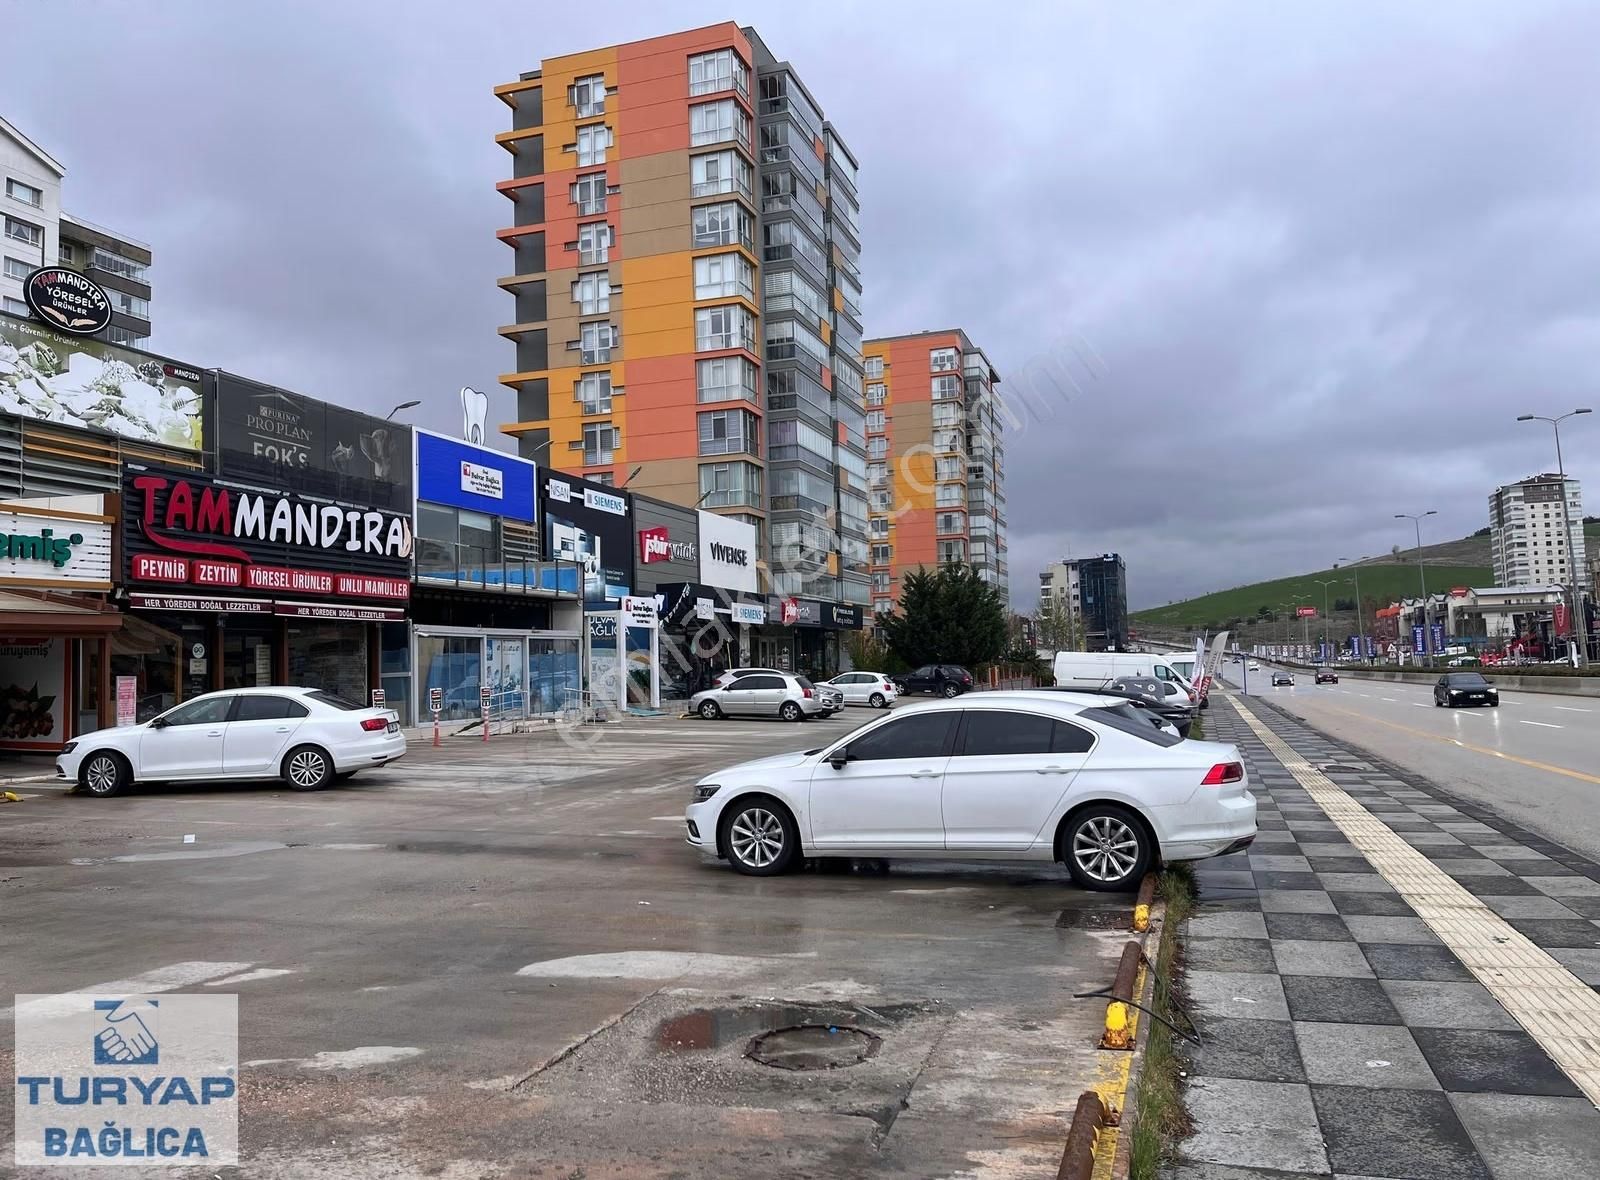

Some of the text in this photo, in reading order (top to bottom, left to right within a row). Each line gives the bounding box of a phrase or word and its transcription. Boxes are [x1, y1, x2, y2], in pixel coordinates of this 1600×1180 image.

[46, 286, 94, 309] YÖRESEL
[52, 298, 88, 316] ÜRÜNLER
[594, 495, 623, 512] SIEMENS
[710, 541, 748, 567] VİVENSE
[140, 558, 186, 581] PEYNİR
[199, 562, 238, 584] ZEYTİN
[249, 568, 332, 591] YÖRESEL ÜRÜNLER
[339, 576, 408, 597] UNLU MAMÜLLER
[144, 598, 261, 612] HER YÖREDEN DOĞAL LEZZETLER
[297, 607, 386, 621] HER YÖREDEN DOĞAL LEZZETLER
[739, 607, 762, 620] SIEMENS
